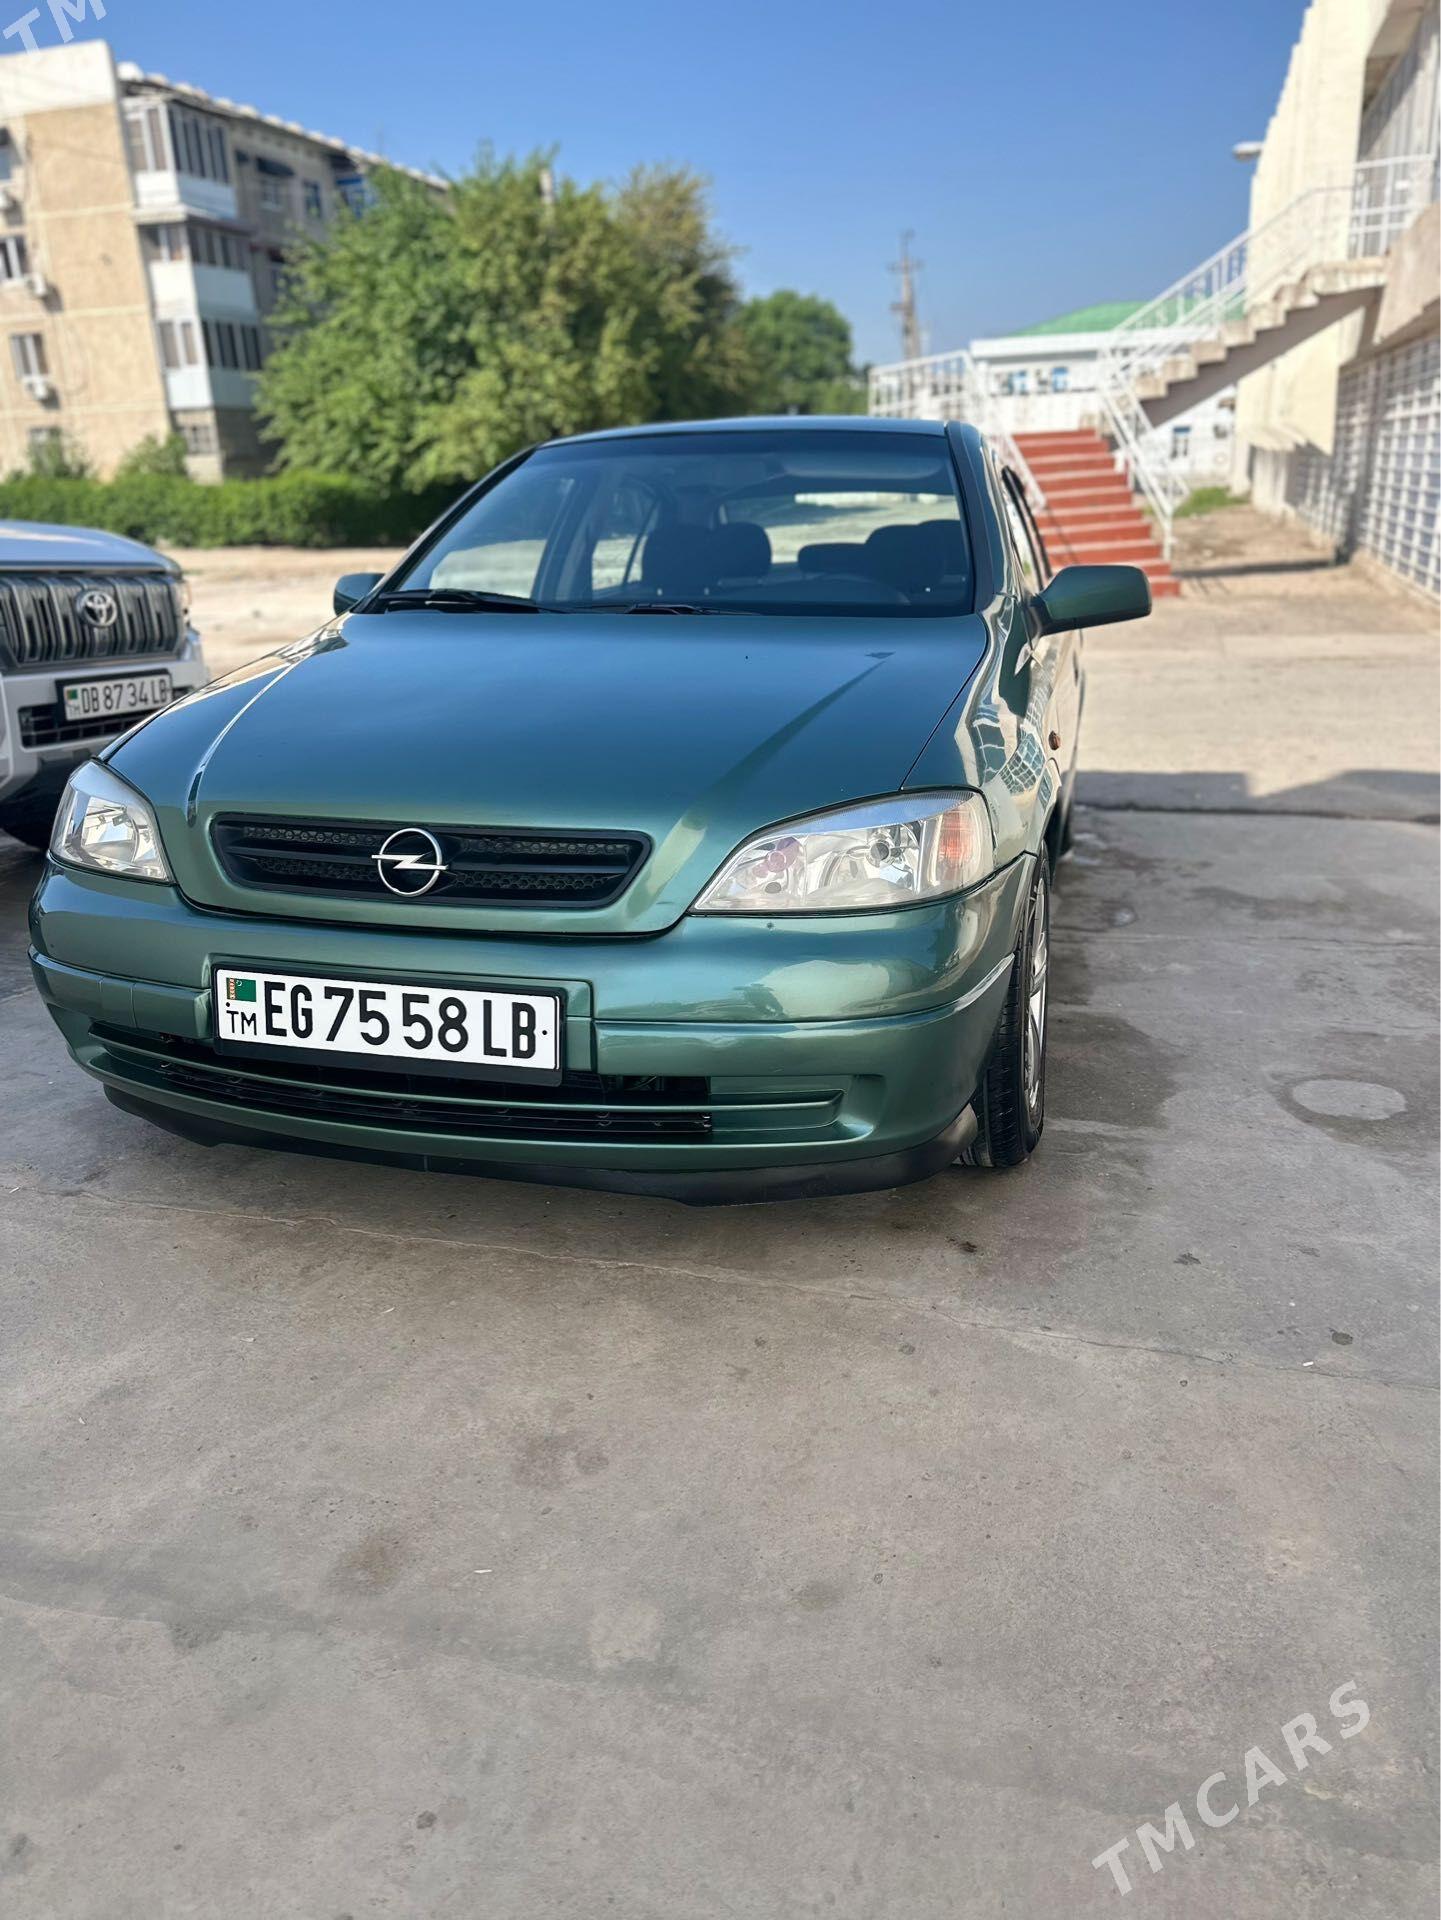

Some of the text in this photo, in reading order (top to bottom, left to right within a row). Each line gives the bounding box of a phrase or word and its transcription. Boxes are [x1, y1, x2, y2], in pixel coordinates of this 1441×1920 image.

[81, 687, 100, 713] DB
[103, 684, 123, 710] 87
[127, 682, 148, 706] 34
[226, 1010, 257, 1036] TM
[264, 980, 536, 1059] EG 75 58 LB
